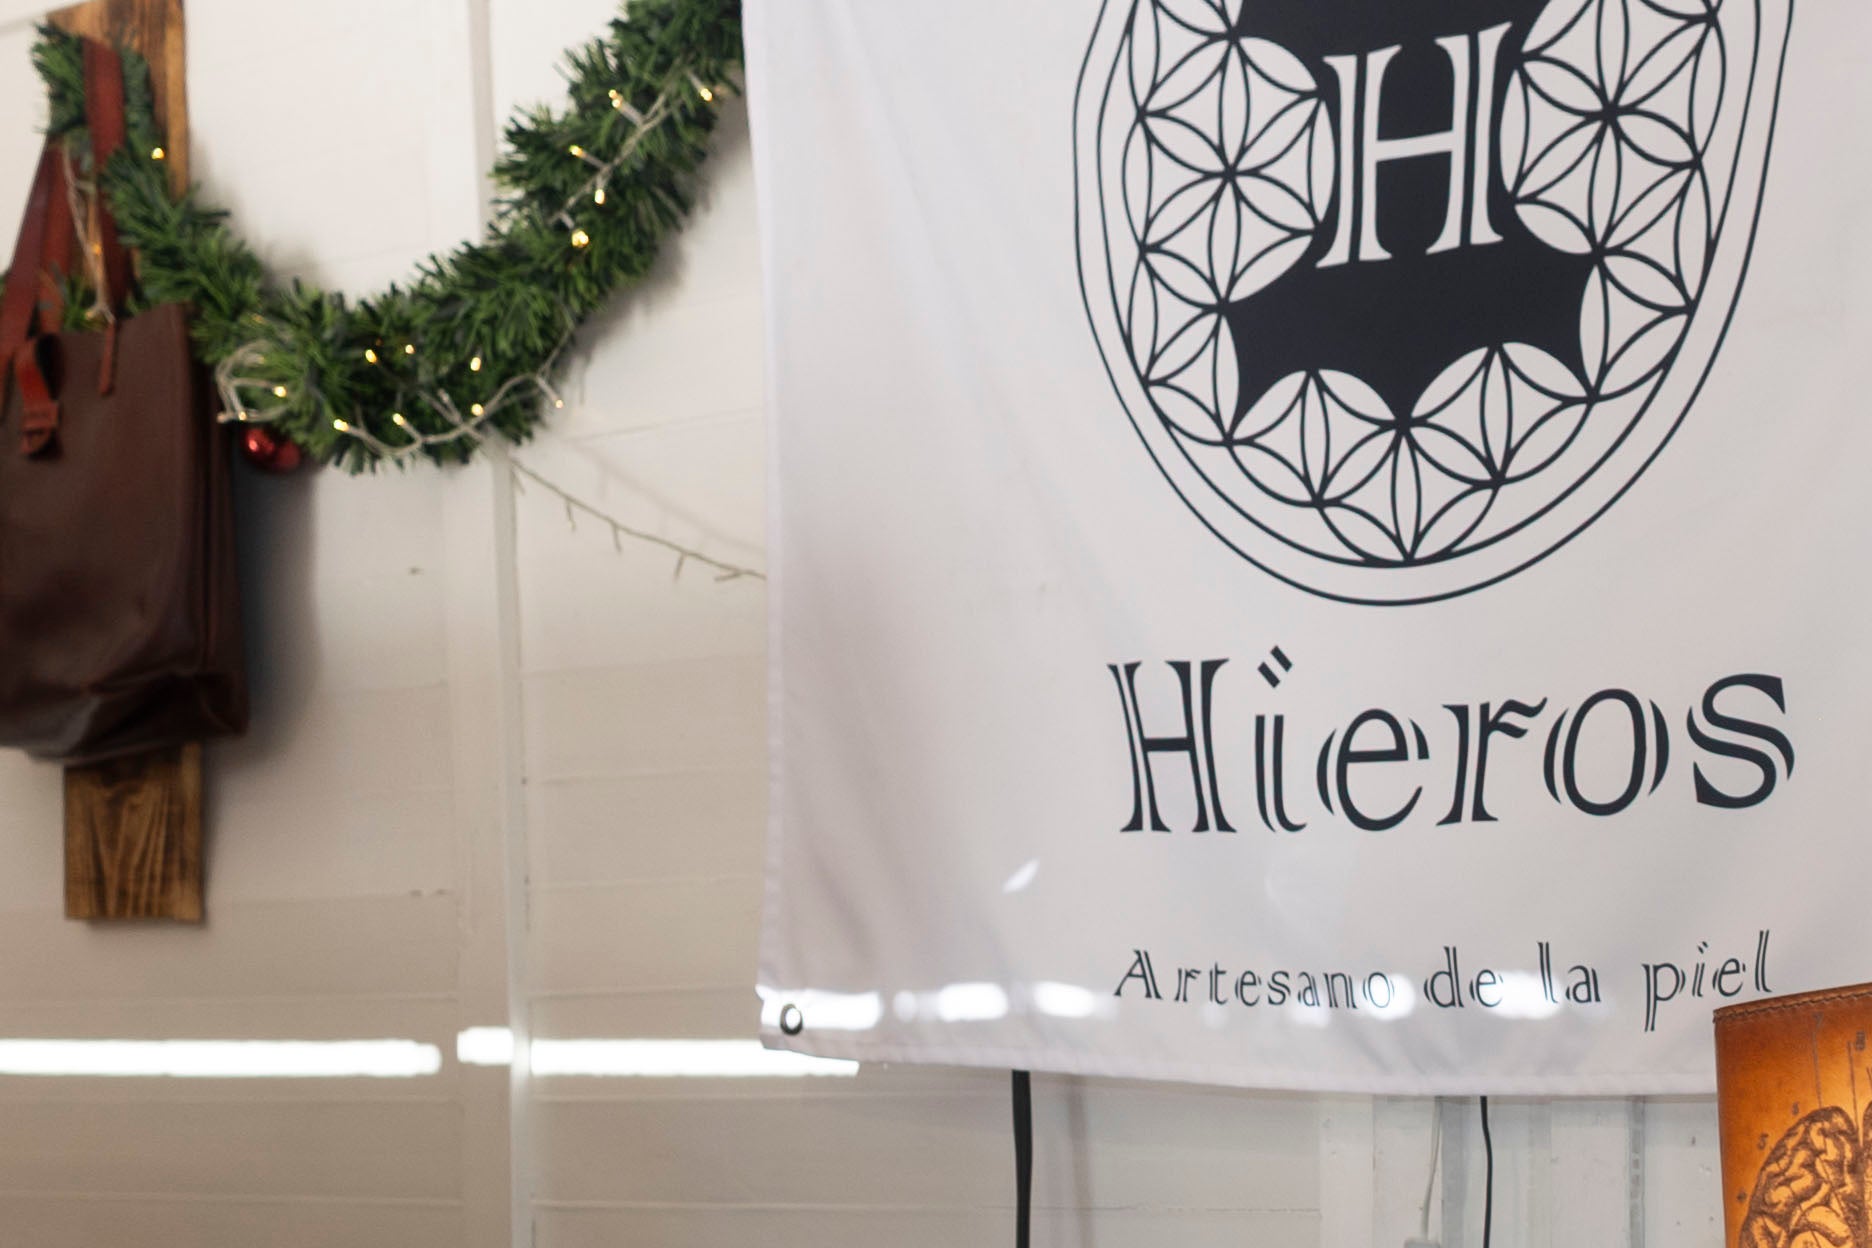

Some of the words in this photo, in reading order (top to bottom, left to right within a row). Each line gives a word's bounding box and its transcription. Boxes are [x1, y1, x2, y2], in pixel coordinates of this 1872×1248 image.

[1315, 21, 1514, 269] H
[1106, 645, 1796, 833] Hieros
[1113, 949, 1396, 1010] Artesano
[1423, 946, 1502, 1009] de
[1537, 941, 1602, 1003] la
[1641, 929, 1773, 1033] piel
